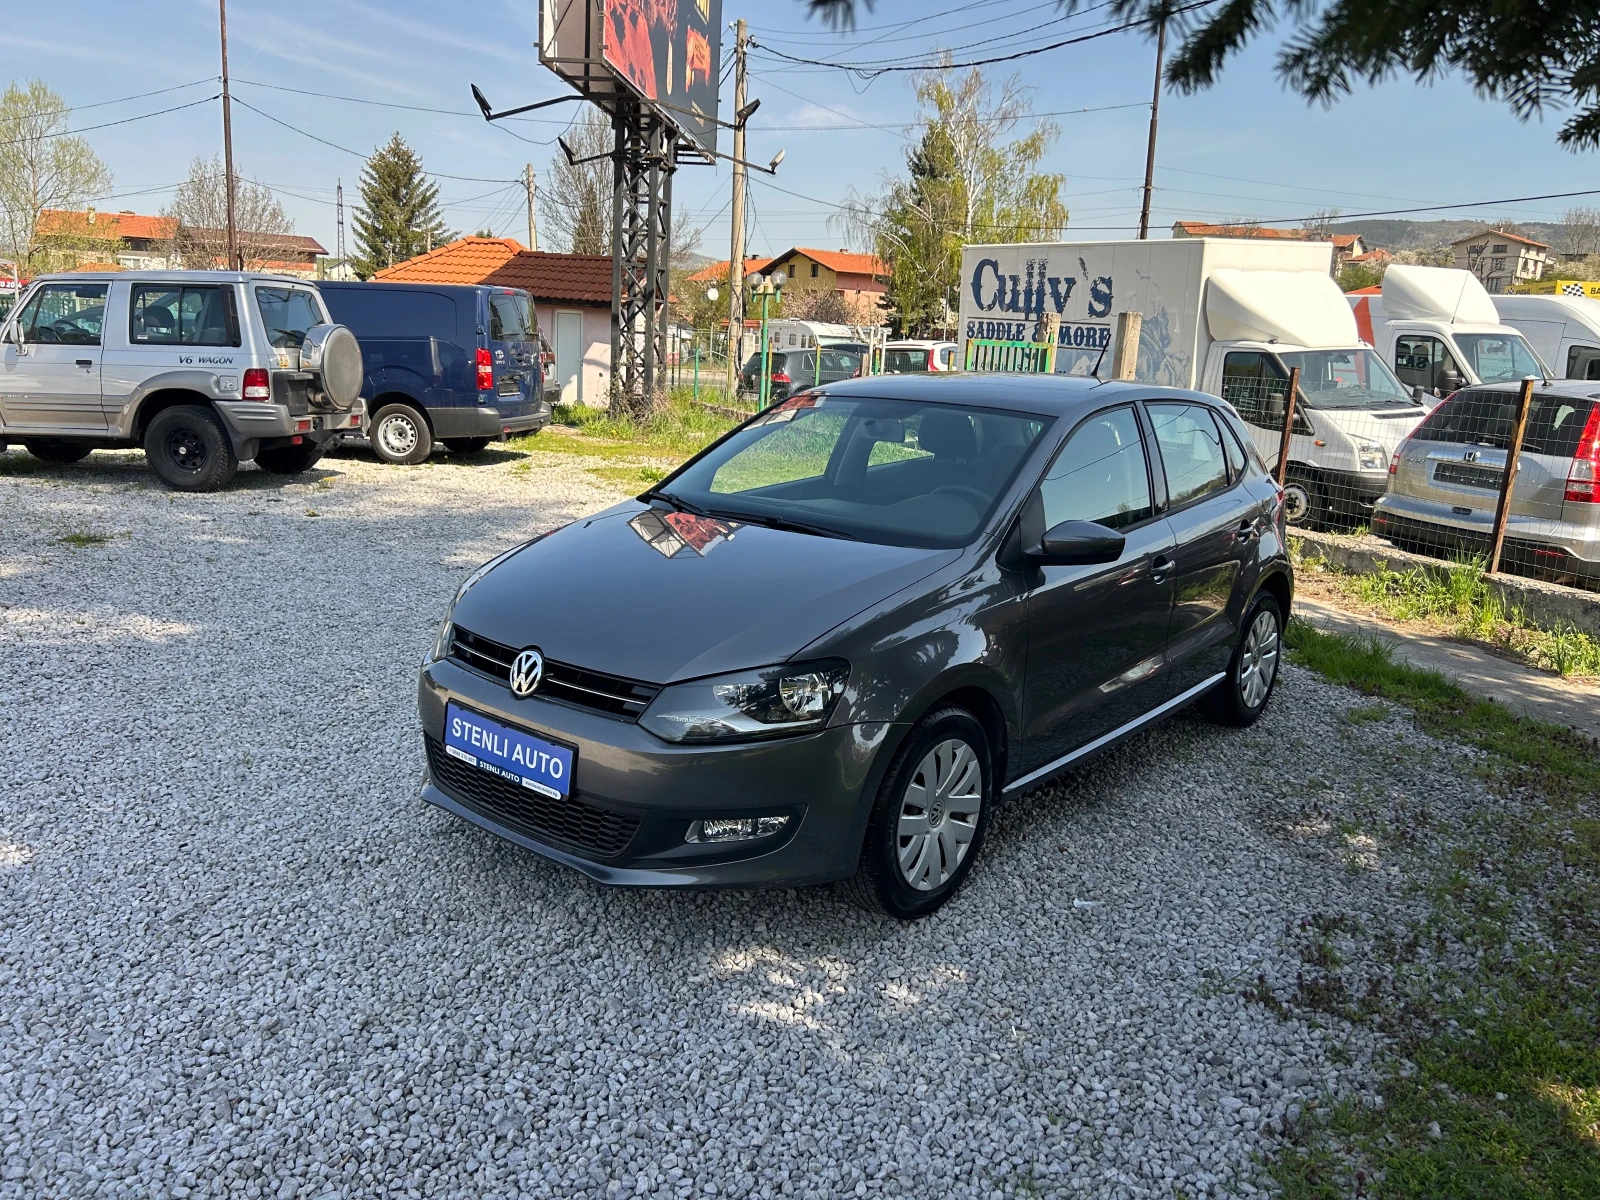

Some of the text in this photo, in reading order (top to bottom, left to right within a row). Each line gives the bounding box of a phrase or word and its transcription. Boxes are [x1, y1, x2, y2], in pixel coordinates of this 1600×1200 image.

[966, 320, 1025, 342] SADDLE
[179, 356, 234, 365] V6 WAGON
[451, 717, 563, 779] STENLI AUTO
[480, 760, 520, 783] STENLI AUTO
